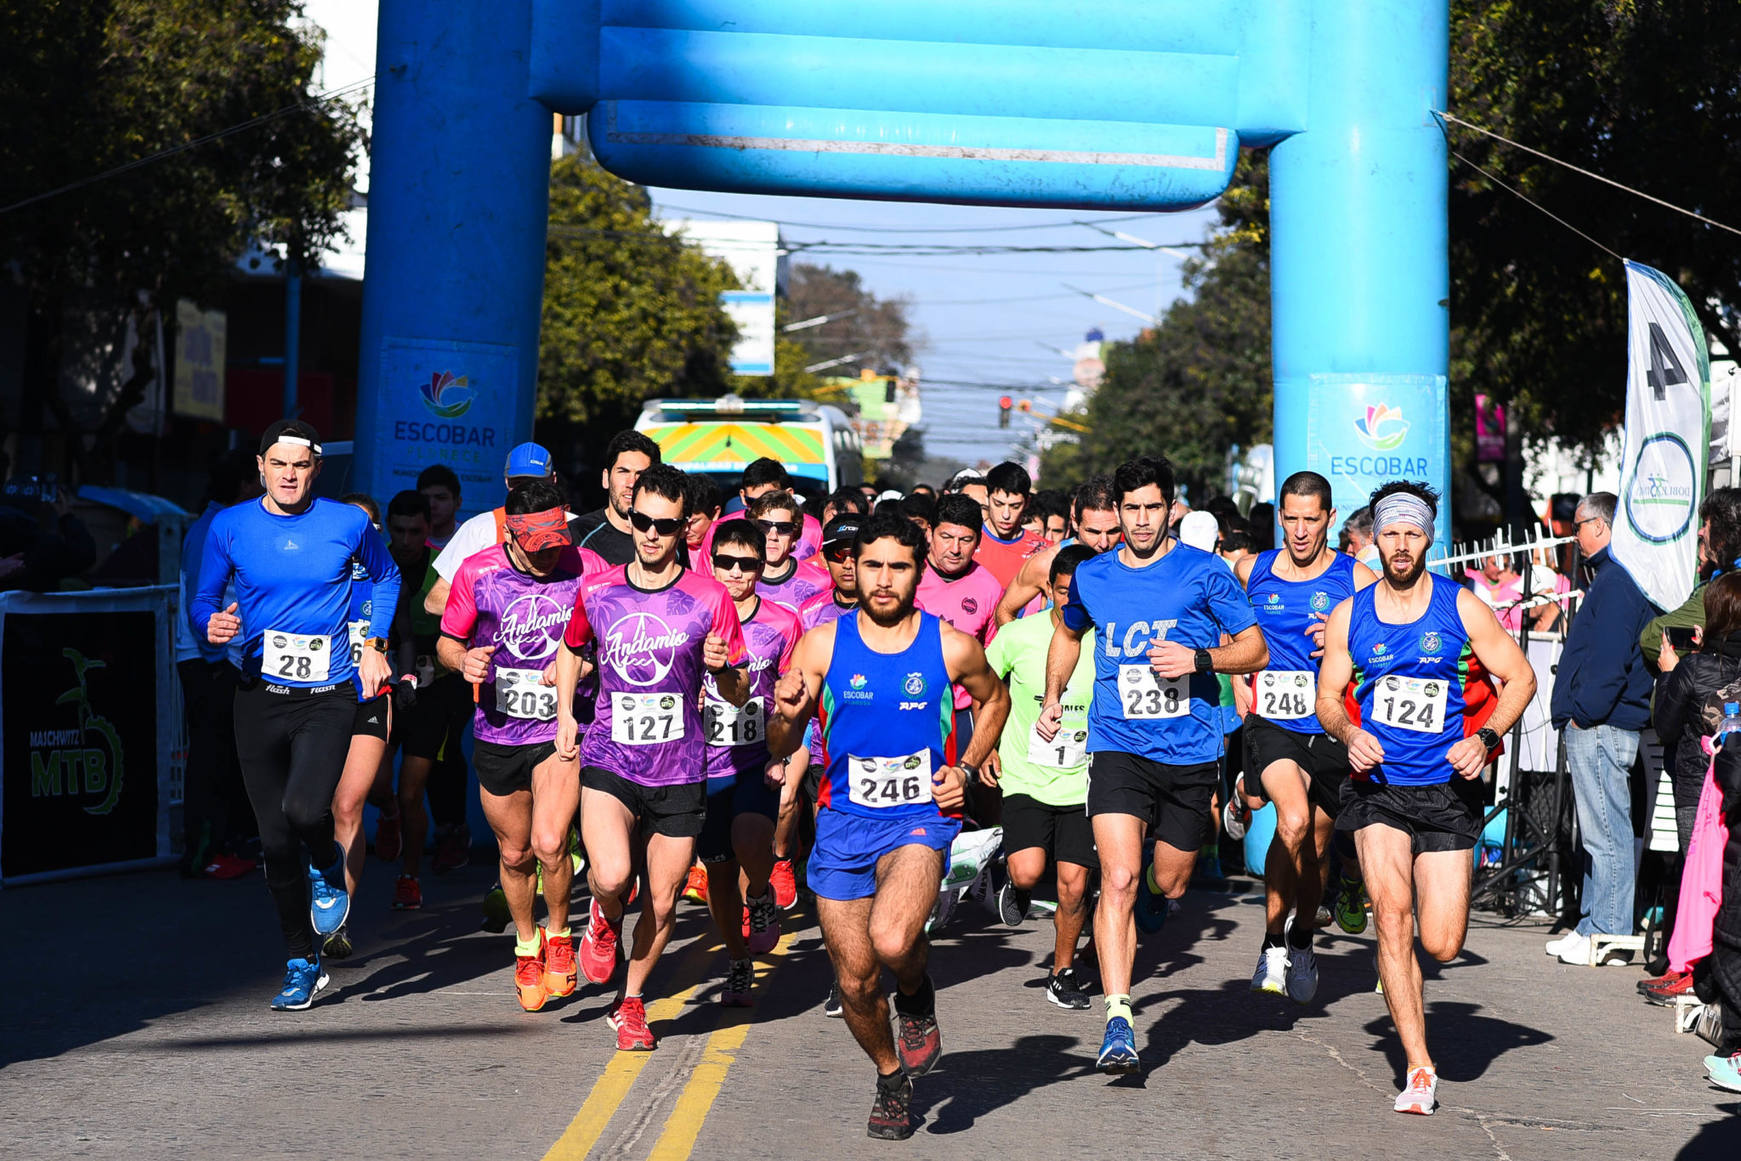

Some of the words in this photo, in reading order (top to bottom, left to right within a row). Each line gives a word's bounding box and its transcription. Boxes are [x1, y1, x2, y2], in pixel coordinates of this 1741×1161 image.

[394, 421, 495, 447] ESCOBAR
[1331, 457, 1428, 477] ESCOBAR
[600, 628, 690, 666] Andamio
[1105, 619, 1178, 658] LCT
[278, 654, 312, 679] 28
[505, 689, 555, 718] 203
[843, 690, 874, 701] ESCOBAR
[1127, 687, 1180, 715] 238
[1264, 692, 1307, 715] 248
[1383, 696, 1434, 729] 124
[30, 729, 80, 747] MASCHWITZ
[622, 714, 674, 741] 127
[709, 719, 758, 743] 218
[1055, 745, 1066, 766] 1
[31, 748, 106, 797] MTB
[860, 775, 921, 803] 246
